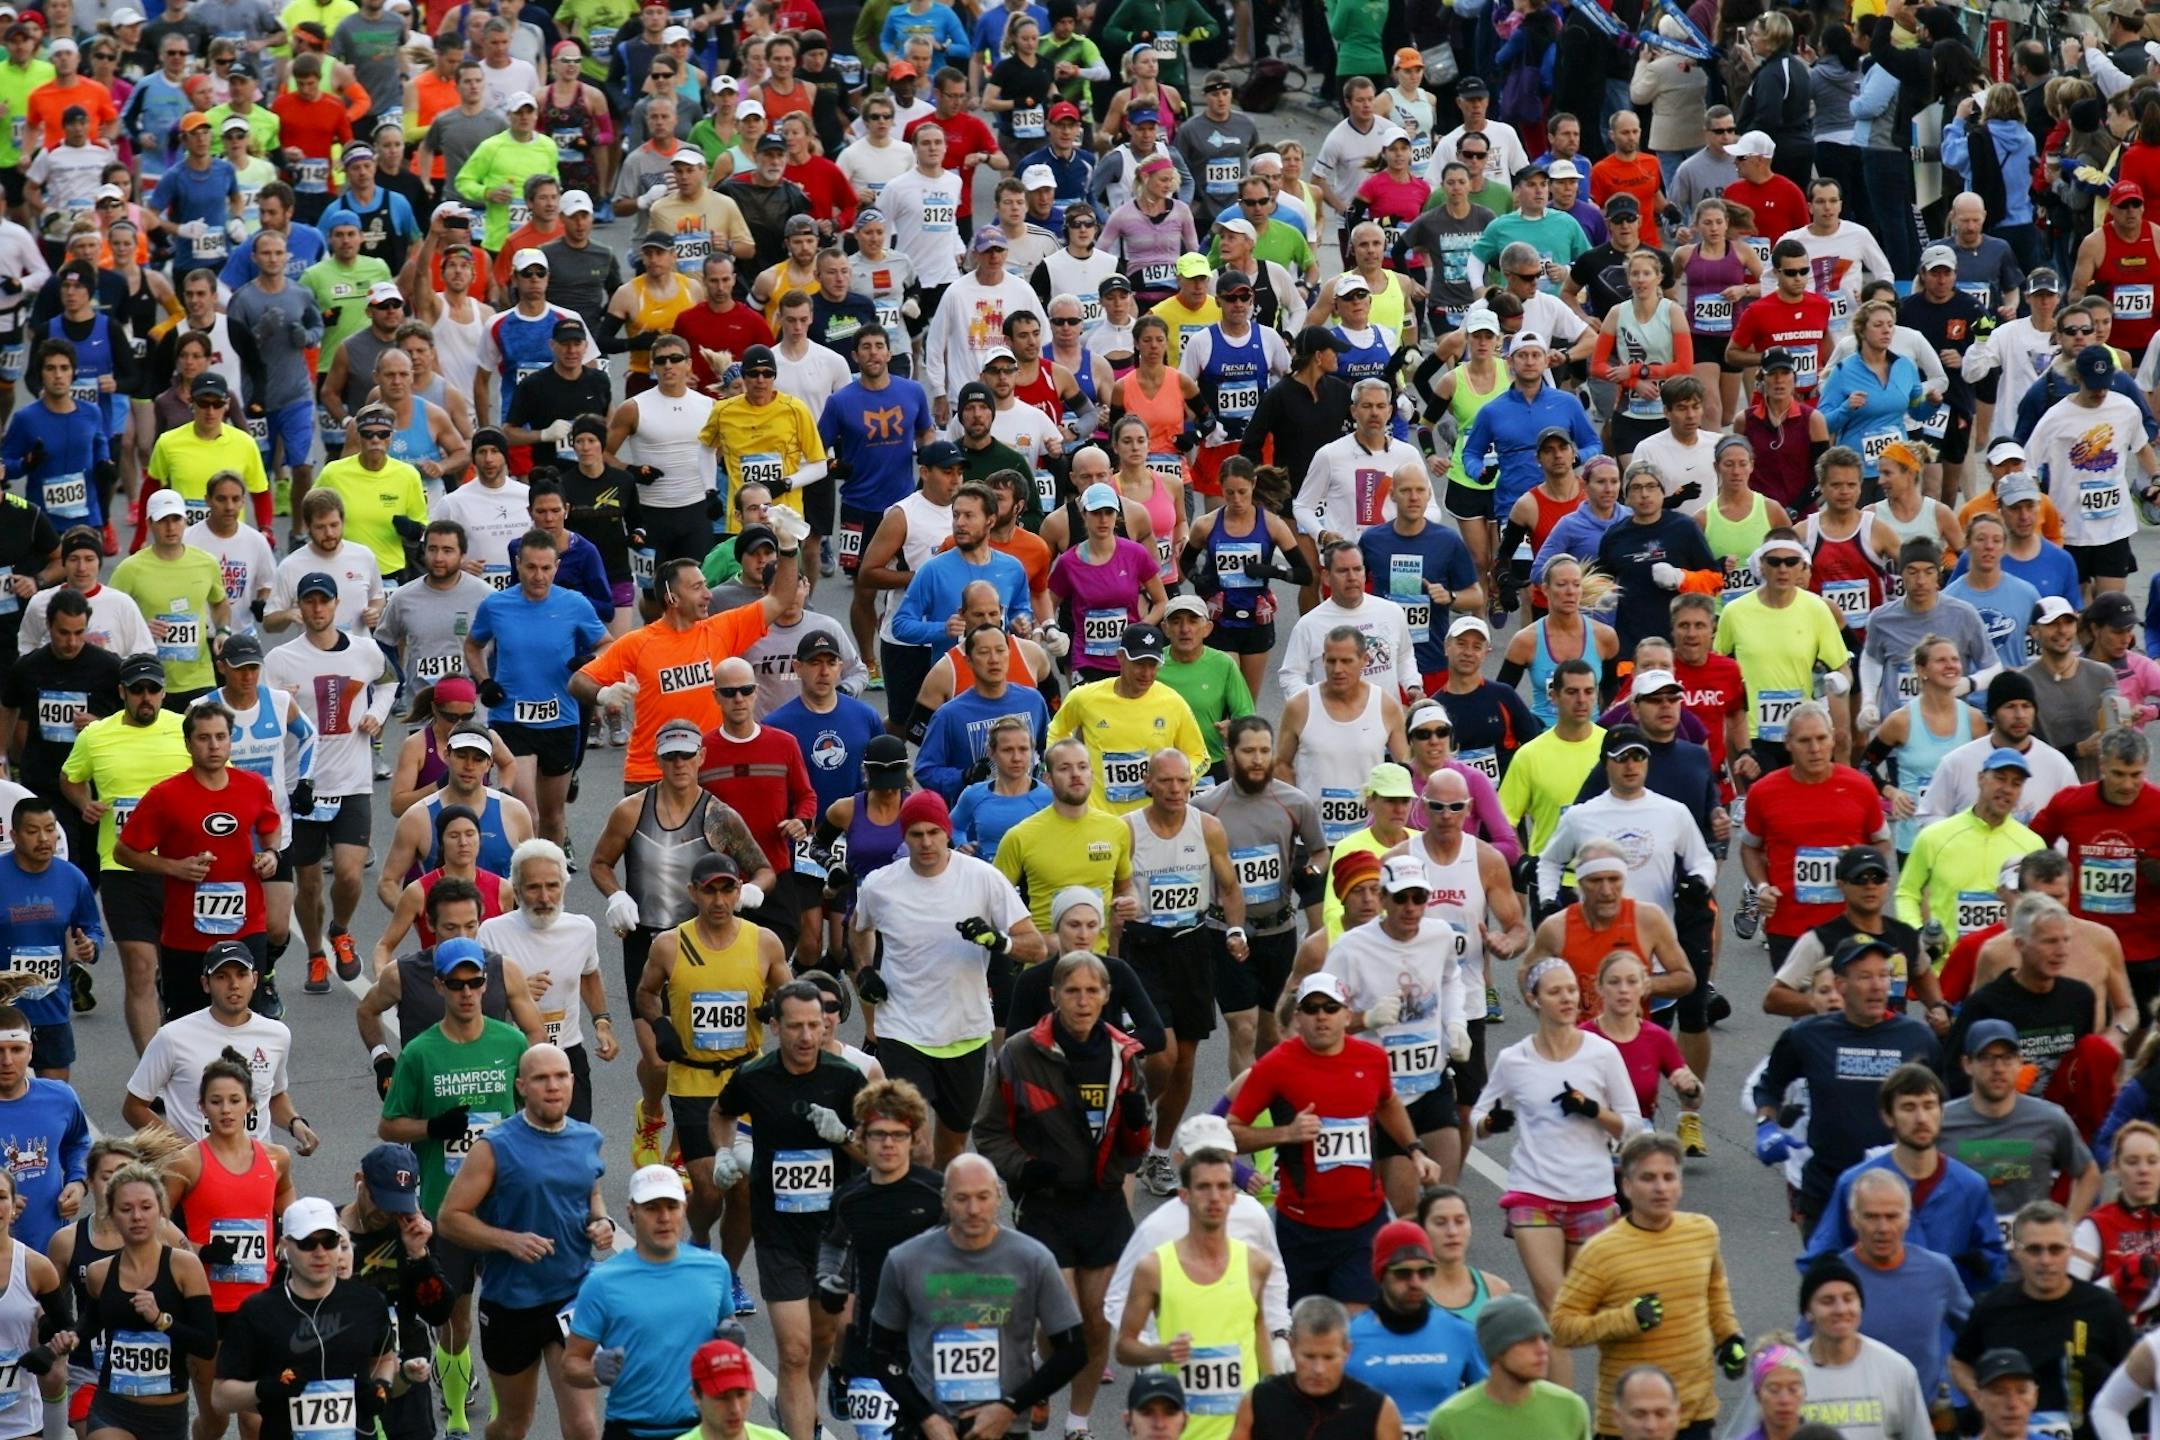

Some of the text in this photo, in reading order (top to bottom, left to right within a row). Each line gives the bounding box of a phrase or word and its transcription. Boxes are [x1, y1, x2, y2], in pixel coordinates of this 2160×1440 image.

[1154, 38, 1178, 51] 033
[1014, 112, 1044, 126] 3135
[1412, 146, 1431, 161] 348
[1208, 166, 1240, 181] 1313
[510, 206, 533, 222] 273
[924, 208, 953, 222] 3129
[677, 242, 711, 257] 2350
[1083, 304, 1104, 319] 307
[1696, 303, 1732, 318] 2480
[1831, 299, 1847, 316] 15
[2116, 294, 2151, 311] 4751
[1220, 391, 1257, 408] 3193
[743, 463, 782, 482] 2945
[46, 484, 86, 504] 4303
[2083, 490, 2120, 508] 4975
[841, 534, 859, 556] 16
[1403, 606, 1428, 625] 63
[165, 626, 197, 645] 291
[1085, 620, 1126, 639] 2997
[419, 656, 462, 675] 4318
[661, 662, 713, 690] BRUCE
[328, 678, 337, 733] MARATHON
[517, 702, 559, 721] 1759
[1759, 703, 1800, 722] 178
[1105, 762, 1148, 783] 1588
[206, 814, 238, 835] G
[1236, 859, 1280, 884] 1848
[2084, 871, 2134, 892] 1342
[197, 896, 244, 916] 1772
[1152, 888, 1199, 911] 2623
[693, 1004, 746, 1027] 2468
[1389, 1047, 1438, 1072] 1157
[434, 1069, 506, 1086] SHAMROCK
[1836, 1064, 1895, 1076] MARATHO
[434, 1083, 490, 1096] SHUFFLE
[459, 1095, 486, 1106] 2013
[446, 1127, 485, 1152] 281
[1316, 1131, 1368, 1156] 3711
[774, 1165, 833, 1190] 2824
[215, 1234, 265, 1259] 779
[111, 1347, 169, 1371] 3596
[937, 1348, 997, 1374] 1252
[1387, 1353, 1448, 1366] BROOKS
[1182, 1363, 1240, 1389] 1916
[292, 1399, 353, 1425] 1787
